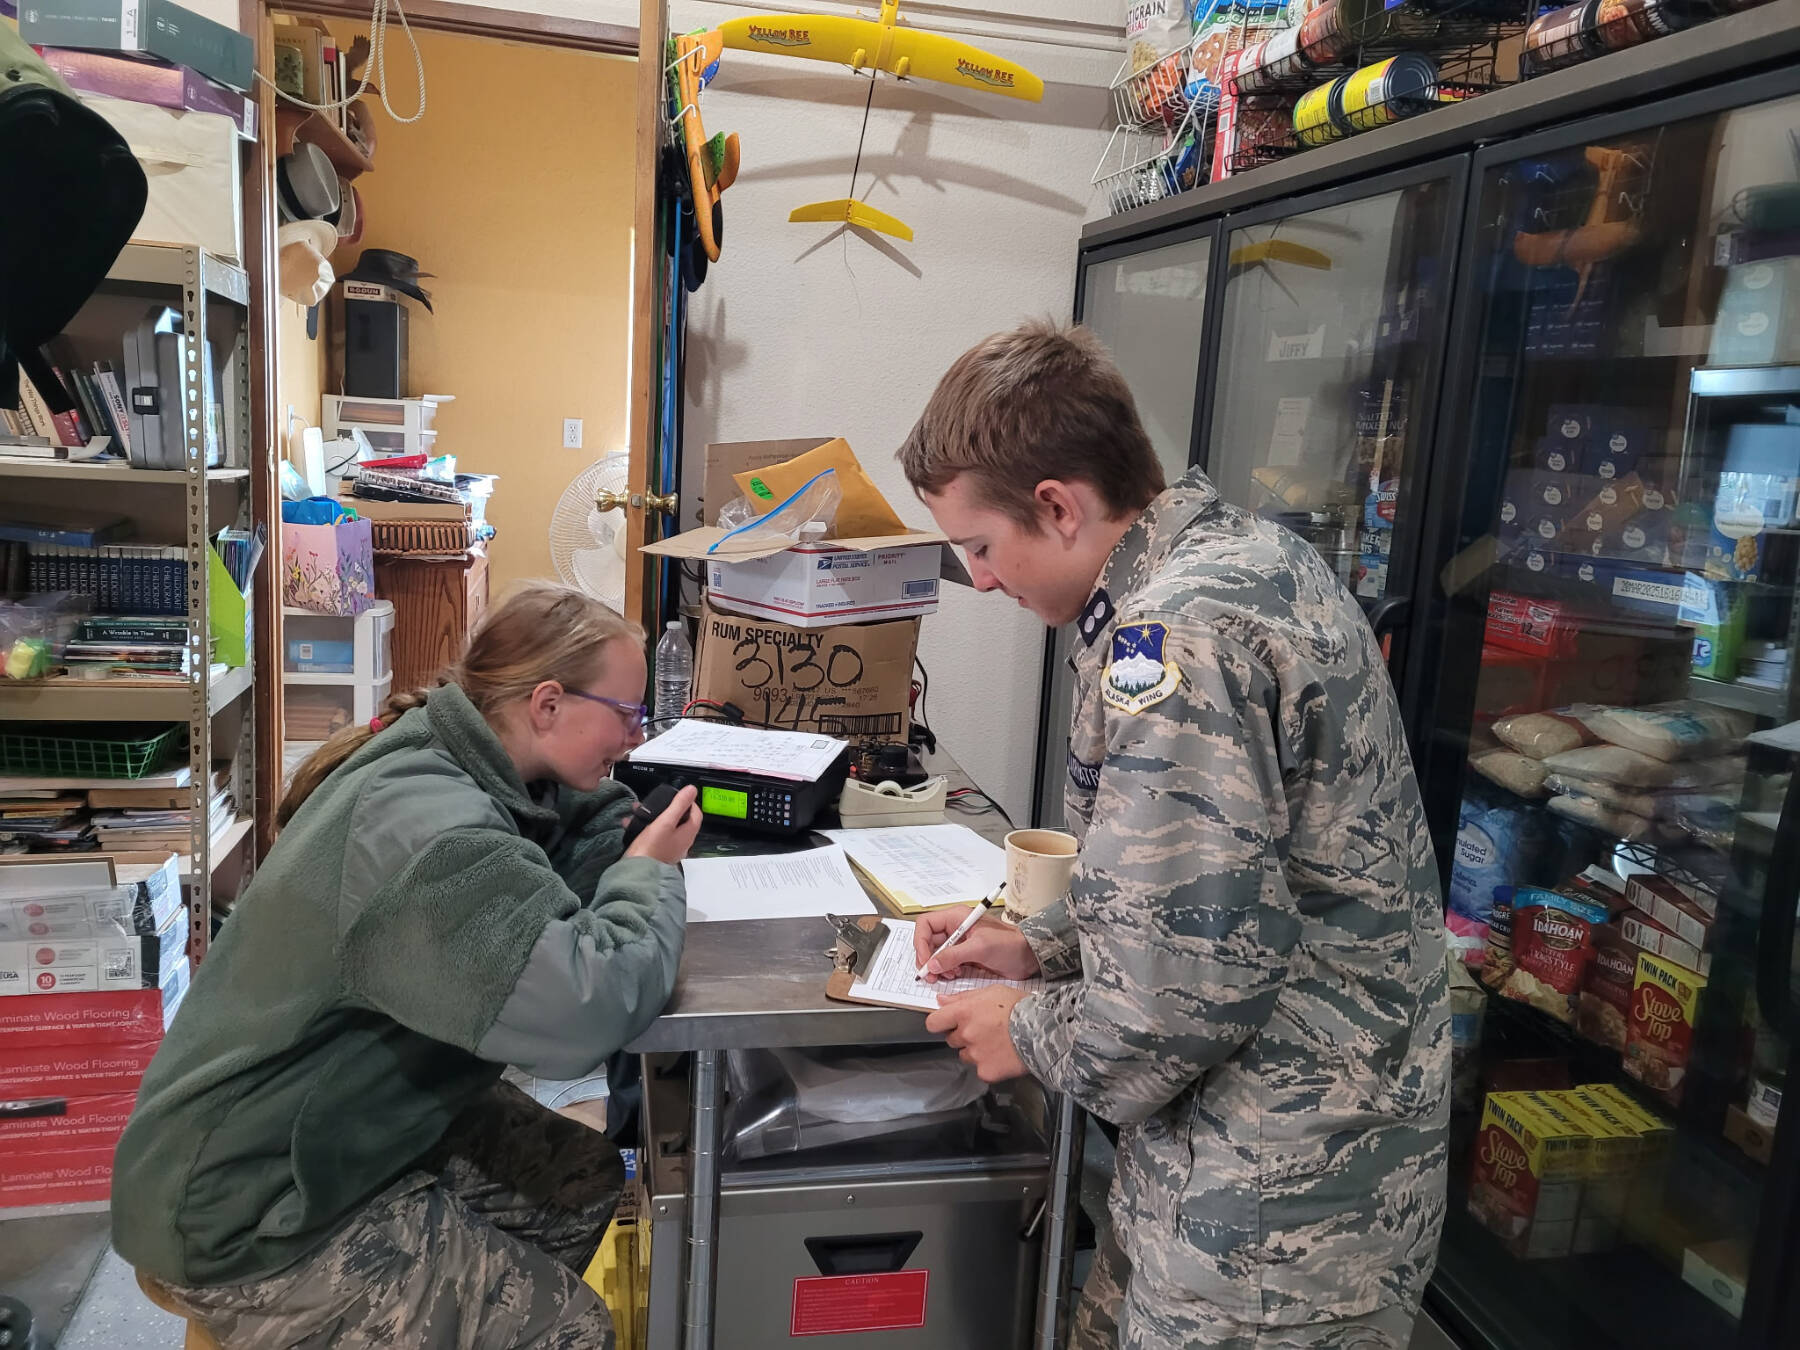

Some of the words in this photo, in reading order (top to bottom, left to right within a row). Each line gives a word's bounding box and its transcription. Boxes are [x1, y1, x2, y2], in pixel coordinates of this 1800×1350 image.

[749, 24, 787, 39] YELLOW
[789, 29, 810, 42] BEE
[958, 58, 993, 78] YELLOW
[994, 69, 1014, 84] BEE
[1279, 338, 1309, 358] JIFFY
[113, 394, 124, 412] SONY
[111, 565, 119, 607] CHILDCRAFT
[152, 566, 160, 609] CHILDCRAFT
[711, 621, 741, 641] RUM
[744, 627, 825, 648] SPECIALTY
[733, 638, 864, 692] 3130
[753, 687, 788, 702] 9093
[1105, 688, 1130, 706] ALASKA
[1138, 690, 1163, 705] WING
[1457, 838, 1487, 856] nulated
[1461, 848, 1485, 865] Sugar
[1530, 893, 1567, 904] FAMILY
[1571, 901, 1595, 915] SIZE
[1533, 919, 1584, 941] IDAHOAN
[1597, 953, 1634, 976] IDAHOAN
[1641, 957, 1658, 977] TWIN
[1659, 969, 1679, 991] PACK
[40, 976, 52, 984] 10
[44, 1011, 79, 1022] Wood
[83, 1008, 130, 1021] Flooring
[1635, 987, 1681, 1022] Stove
[1646, 1016, 1672, 1042] Top
[54, 1060, 89, 1071] Wood
[92, 1058, 139, 1070] Flooring
[51, 1116, 86, 1127] Wood
[1488, 1098, 1505, 1122] TWIN
[1505, 1113, 1524, 1137] PACK
[1599, 1107, 1622, 1126] PACK
[1481, 1130, 1527, 1169] Stove
[2, 1170, 55, 1183] Laminate
[56, 1167, 91, 1178] Wood
[1492, 1165, 1518, 1189] Top
[845, 1277, 880, 1286] CAUTION
